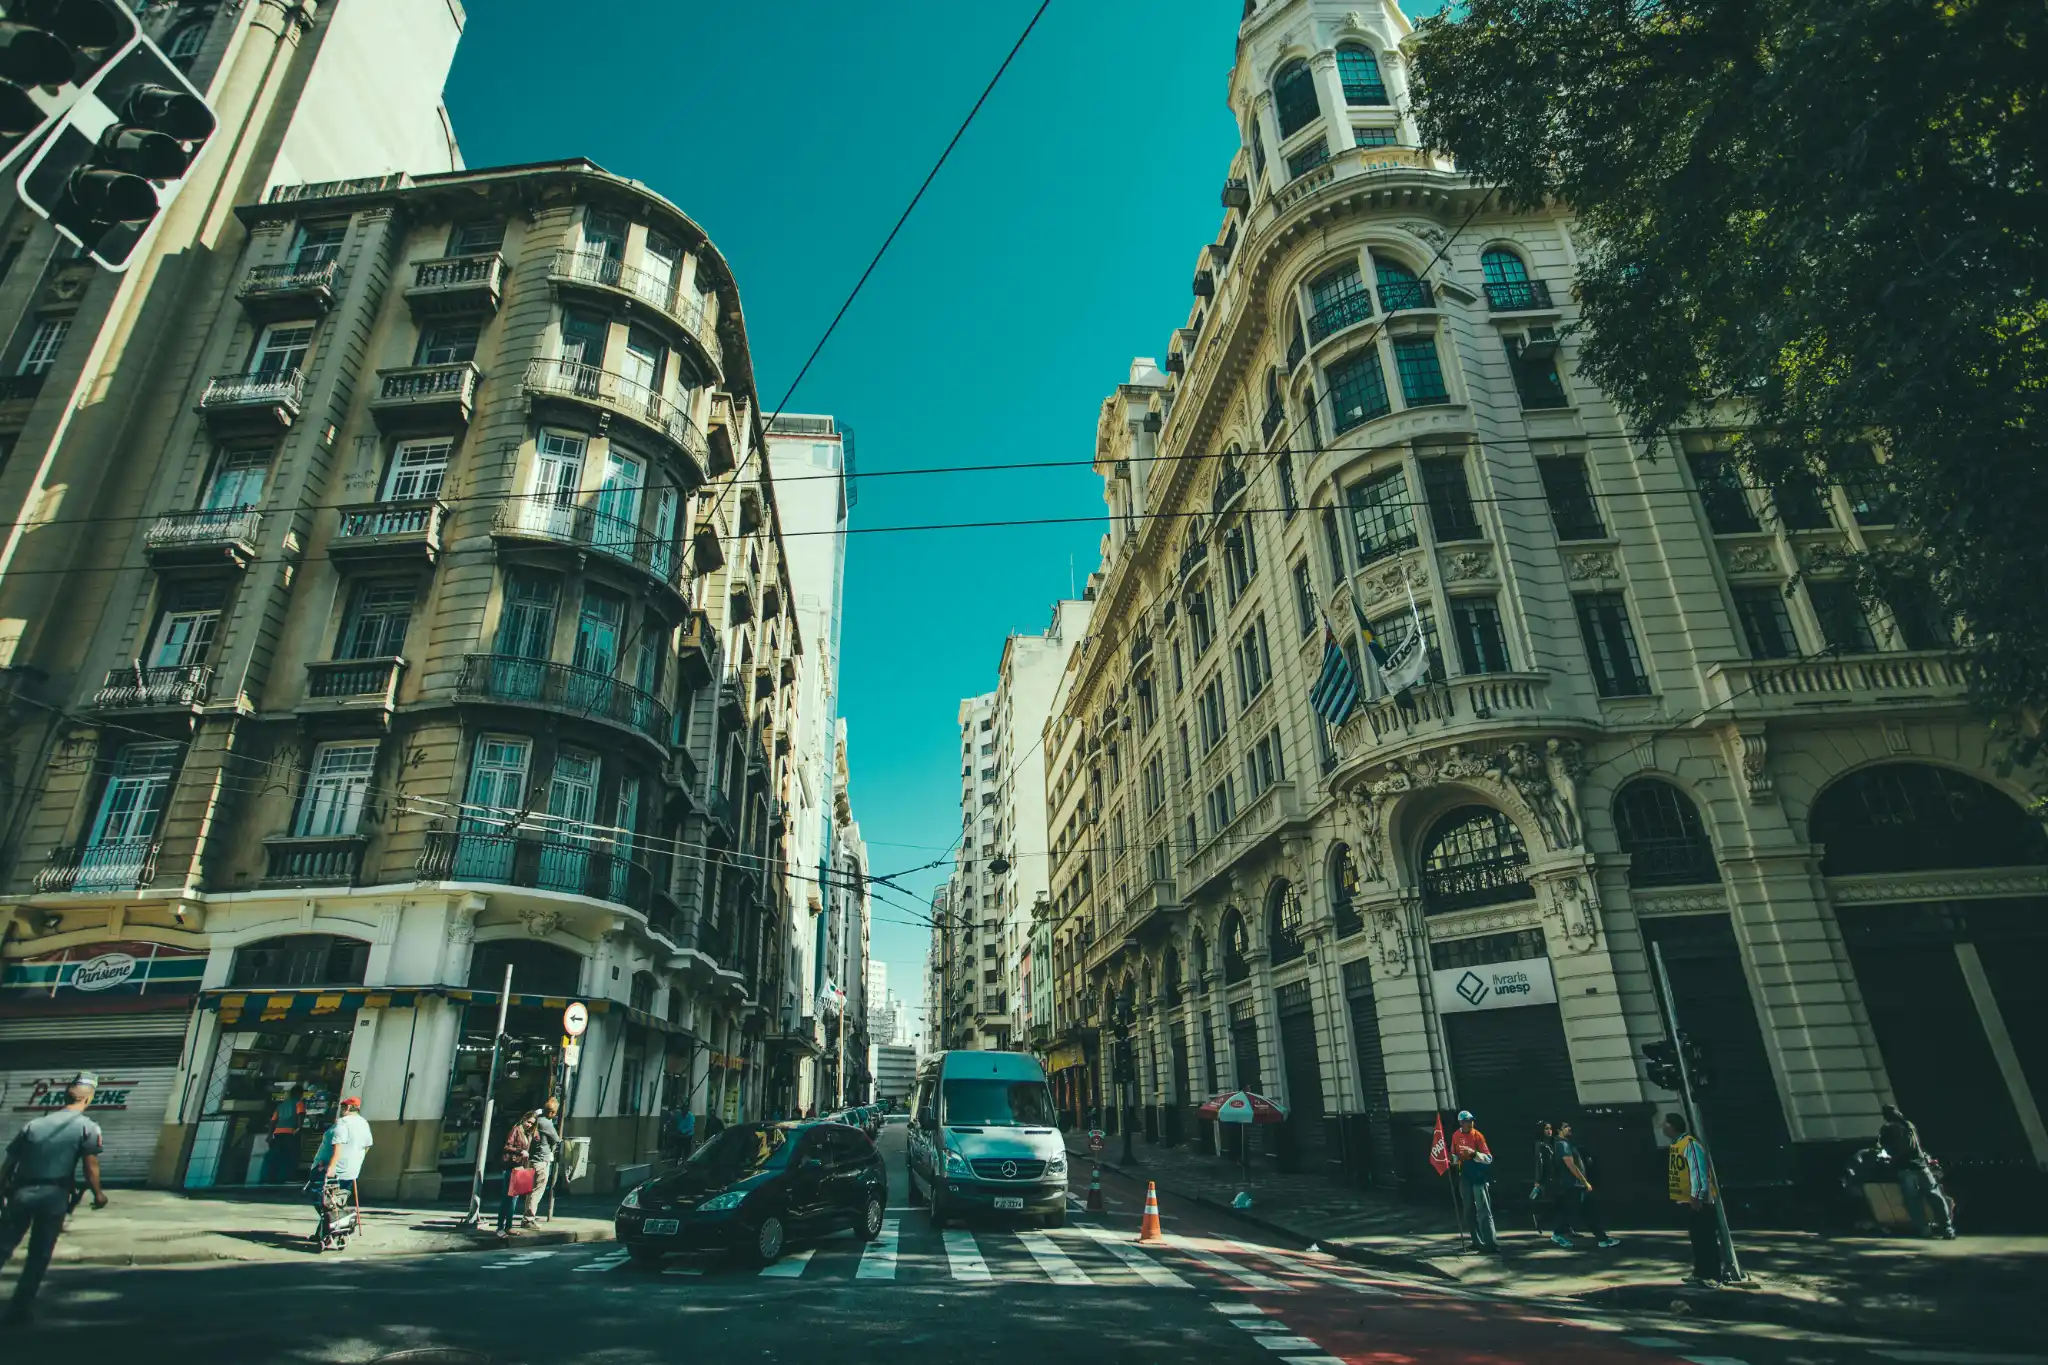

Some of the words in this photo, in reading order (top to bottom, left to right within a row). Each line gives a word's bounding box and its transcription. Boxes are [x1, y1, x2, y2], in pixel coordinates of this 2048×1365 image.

[75, 965, 131, 985] Parisiene
[1492, 972, 1527, 984] livraria
[1495, 983, 1530, 995] unesp
[28, 1079, 131, 1105] PARENE
